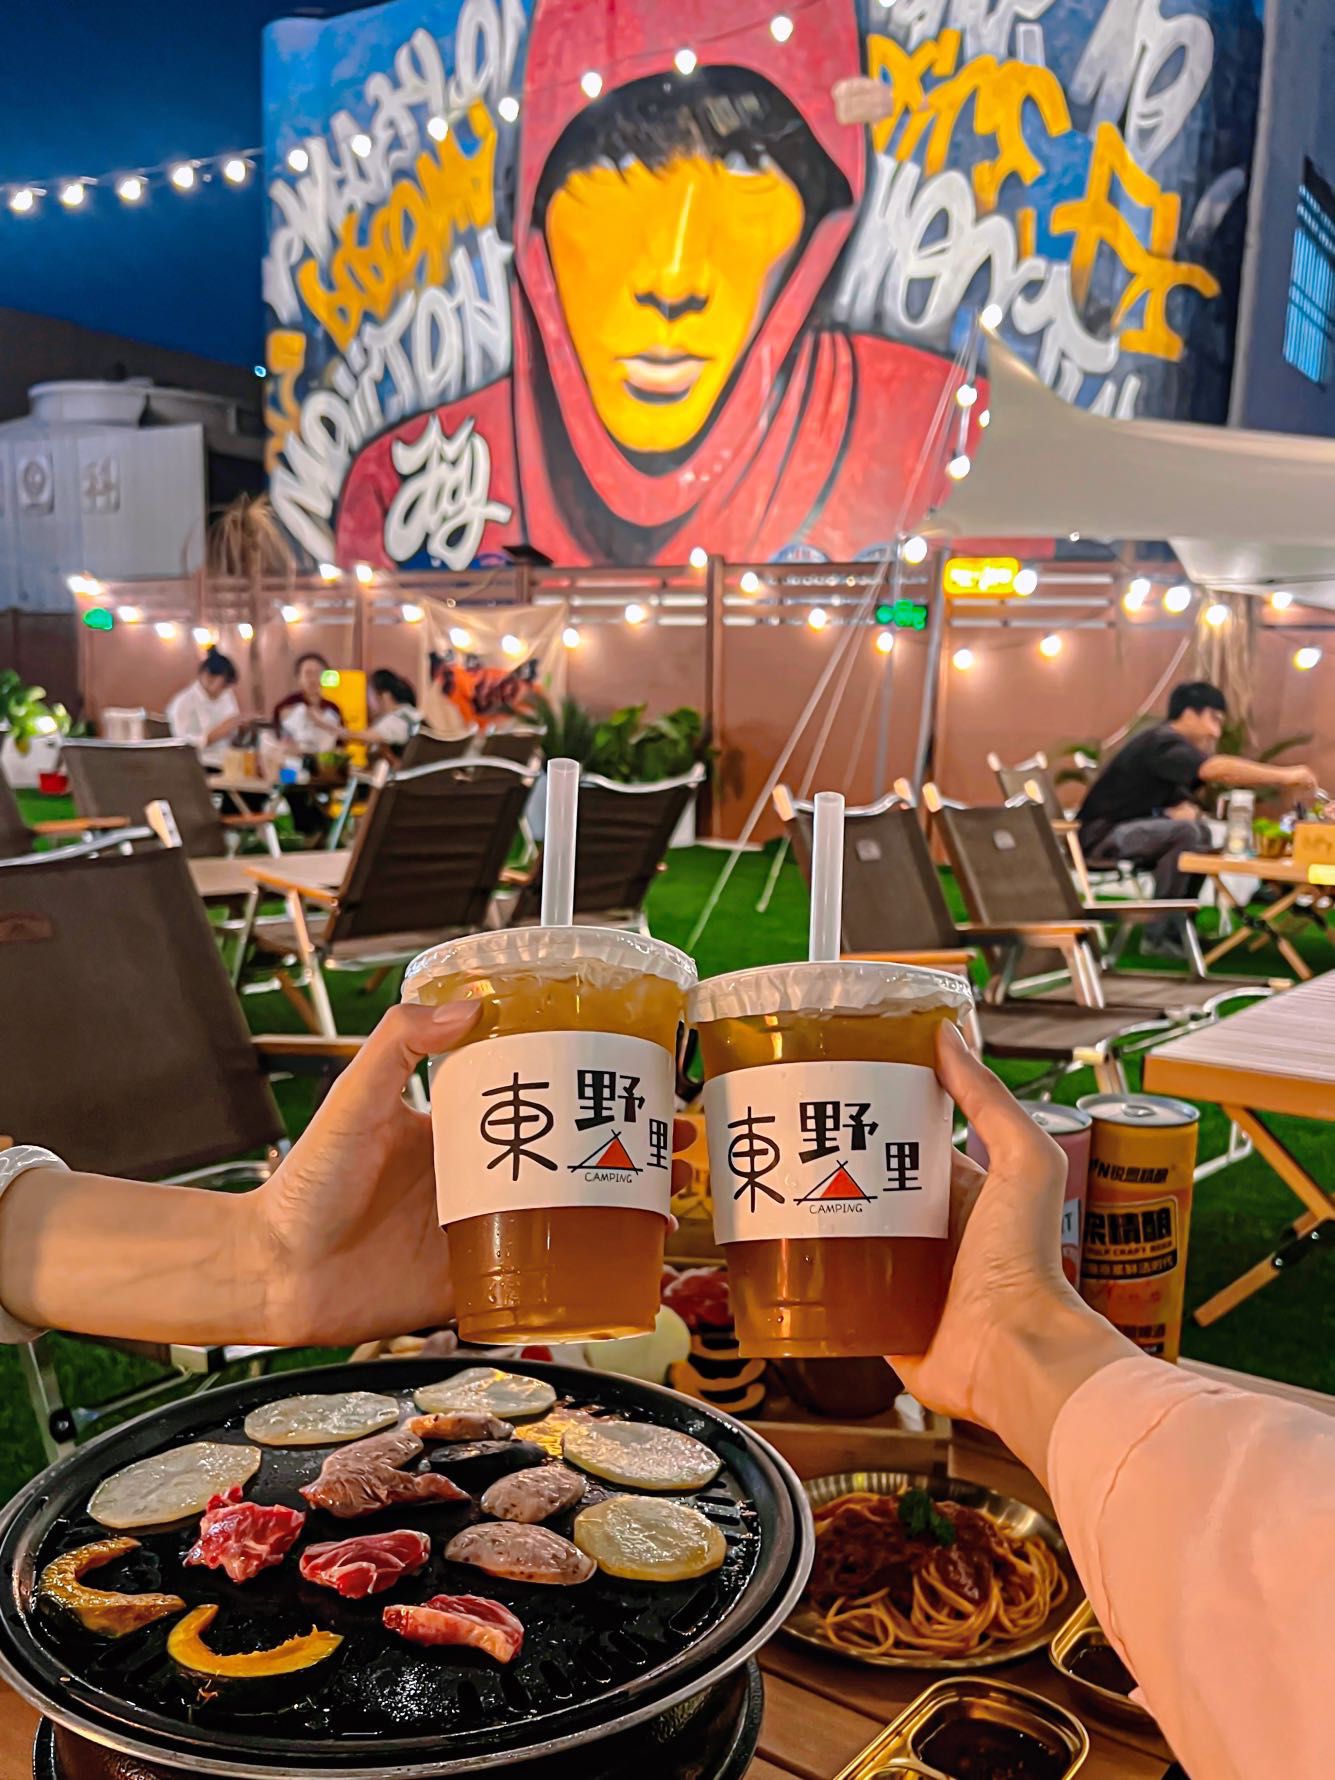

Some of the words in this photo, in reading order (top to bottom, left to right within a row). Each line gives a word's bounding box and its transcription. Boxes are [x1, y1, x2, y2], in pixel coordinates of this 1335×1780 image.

[480, 1069, 668, 1182] 東野里
[584, 1172, 633, 1183] CAMPING
[727, 1101, 922, 1213] 東野里
[809, 1203, 863, 1214] CAMPING
